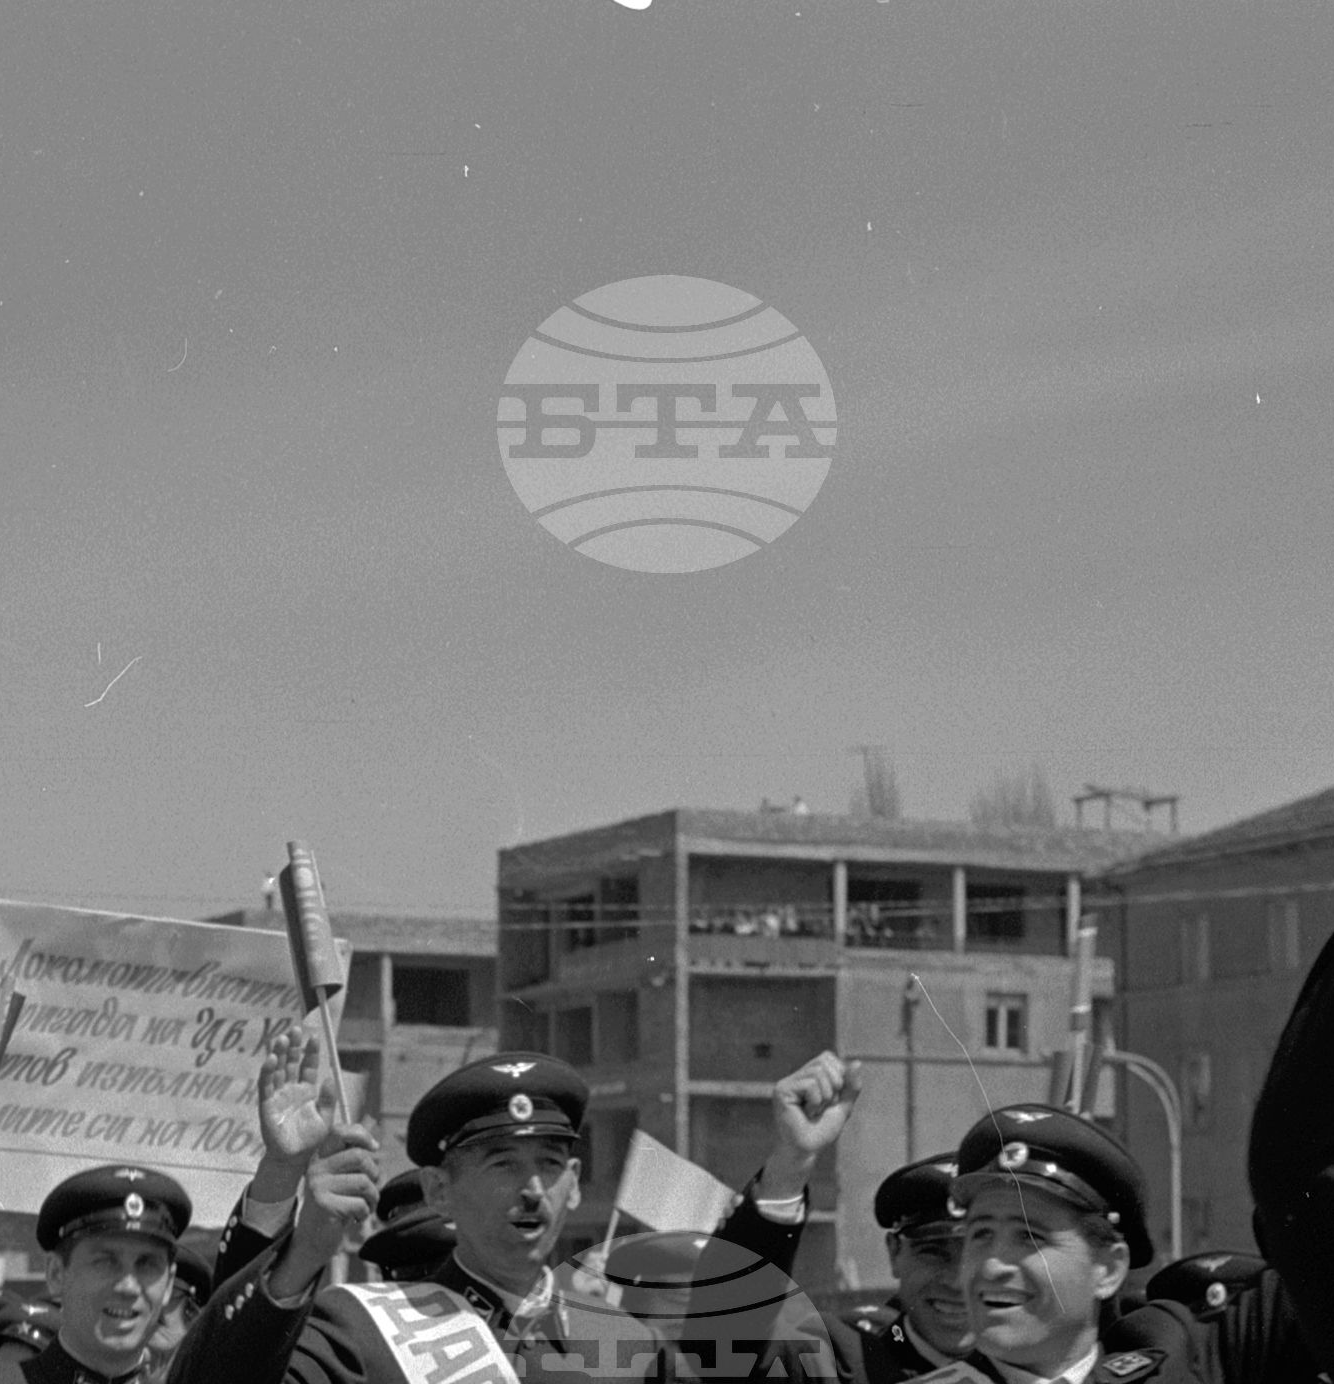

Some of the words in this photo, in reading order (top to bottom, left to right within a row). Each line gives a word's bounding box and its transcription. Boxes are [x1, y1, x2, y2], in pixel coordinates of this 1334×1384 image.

[140, 1017, 186, 1045] на
[75, 1062, 234, 1101] изпълни
[84, 1113, 135, 1144] си
[137, 1117, 189, 1147] на
